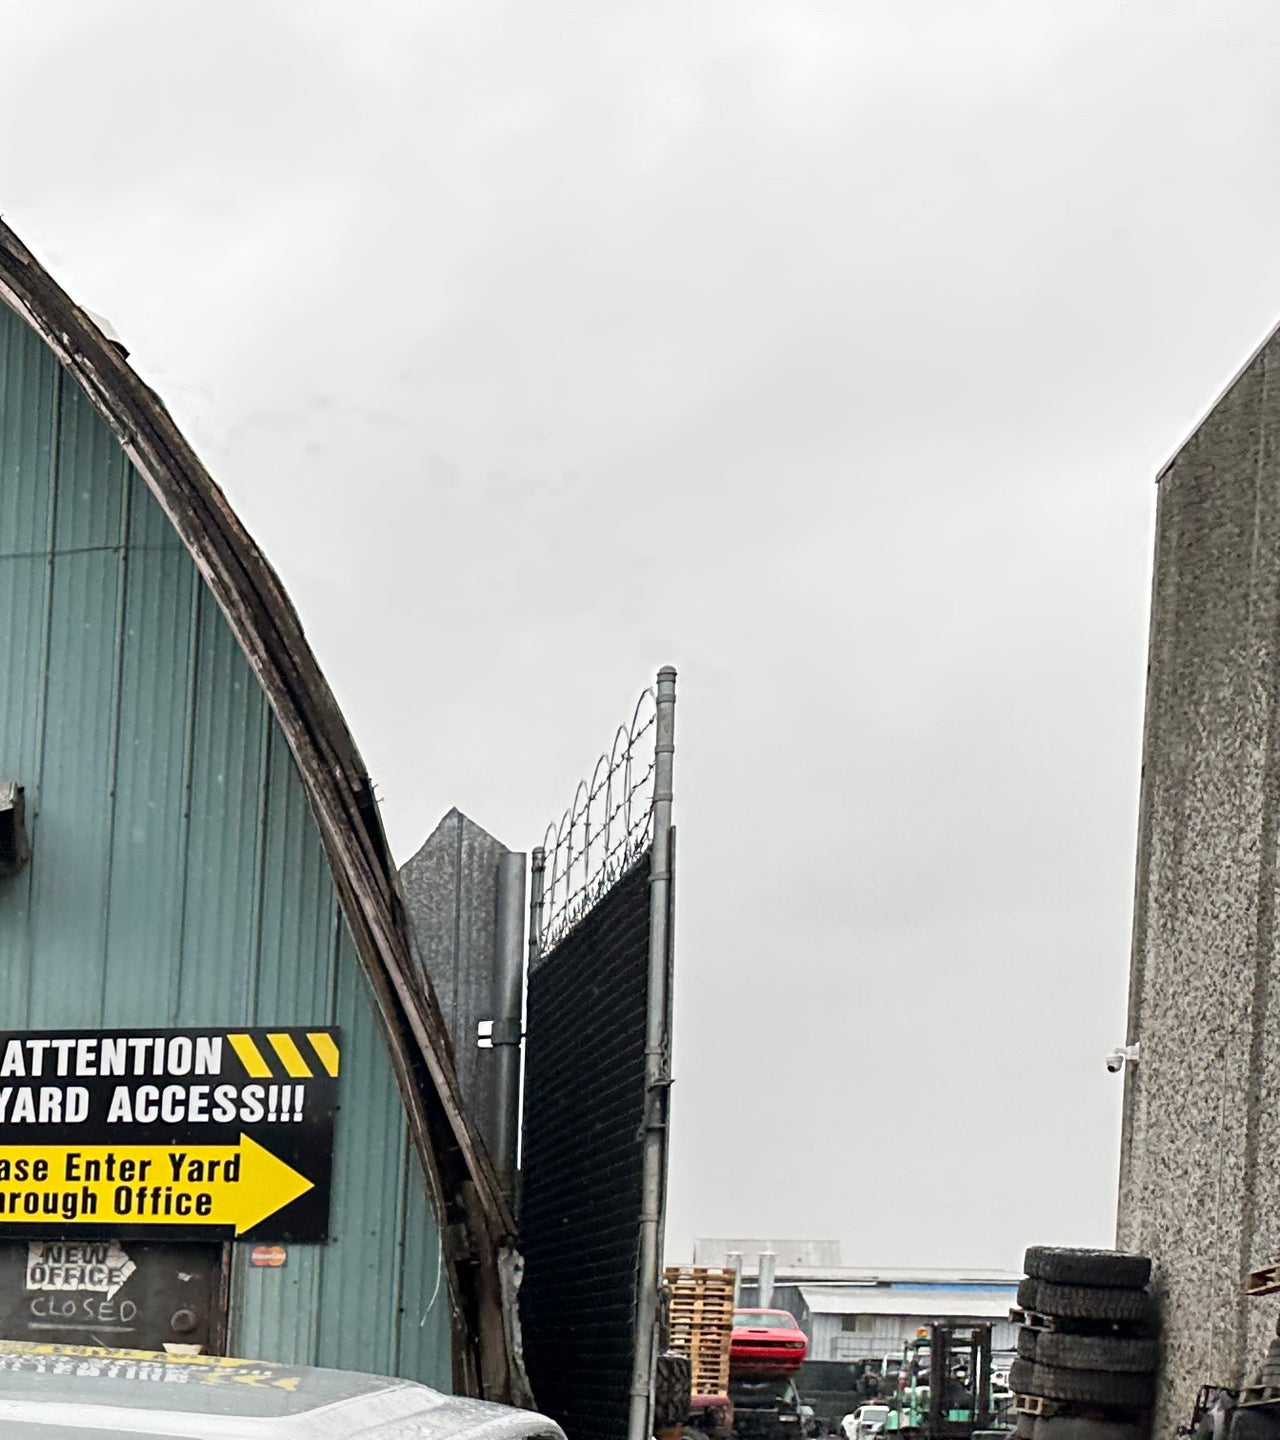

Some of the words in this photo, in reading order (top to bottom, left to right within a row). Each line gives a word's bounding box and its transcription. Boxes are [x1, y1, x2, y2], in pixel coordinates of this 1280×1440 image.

[0, 1035, 223, 1078] ATTENTION
[105, 1083, 306, 1124] ACCESS!!!
[64, 1152, 153, 1182] Enter
[168, 1152, 241, 1183] Yard
[113, 1185, 214, 1217] Office
[41, 1242, 108, 1265] NEW
[29, 1263, 123, 1287] OFFICE
[30, 1296, 138, 1323] CLOSED
